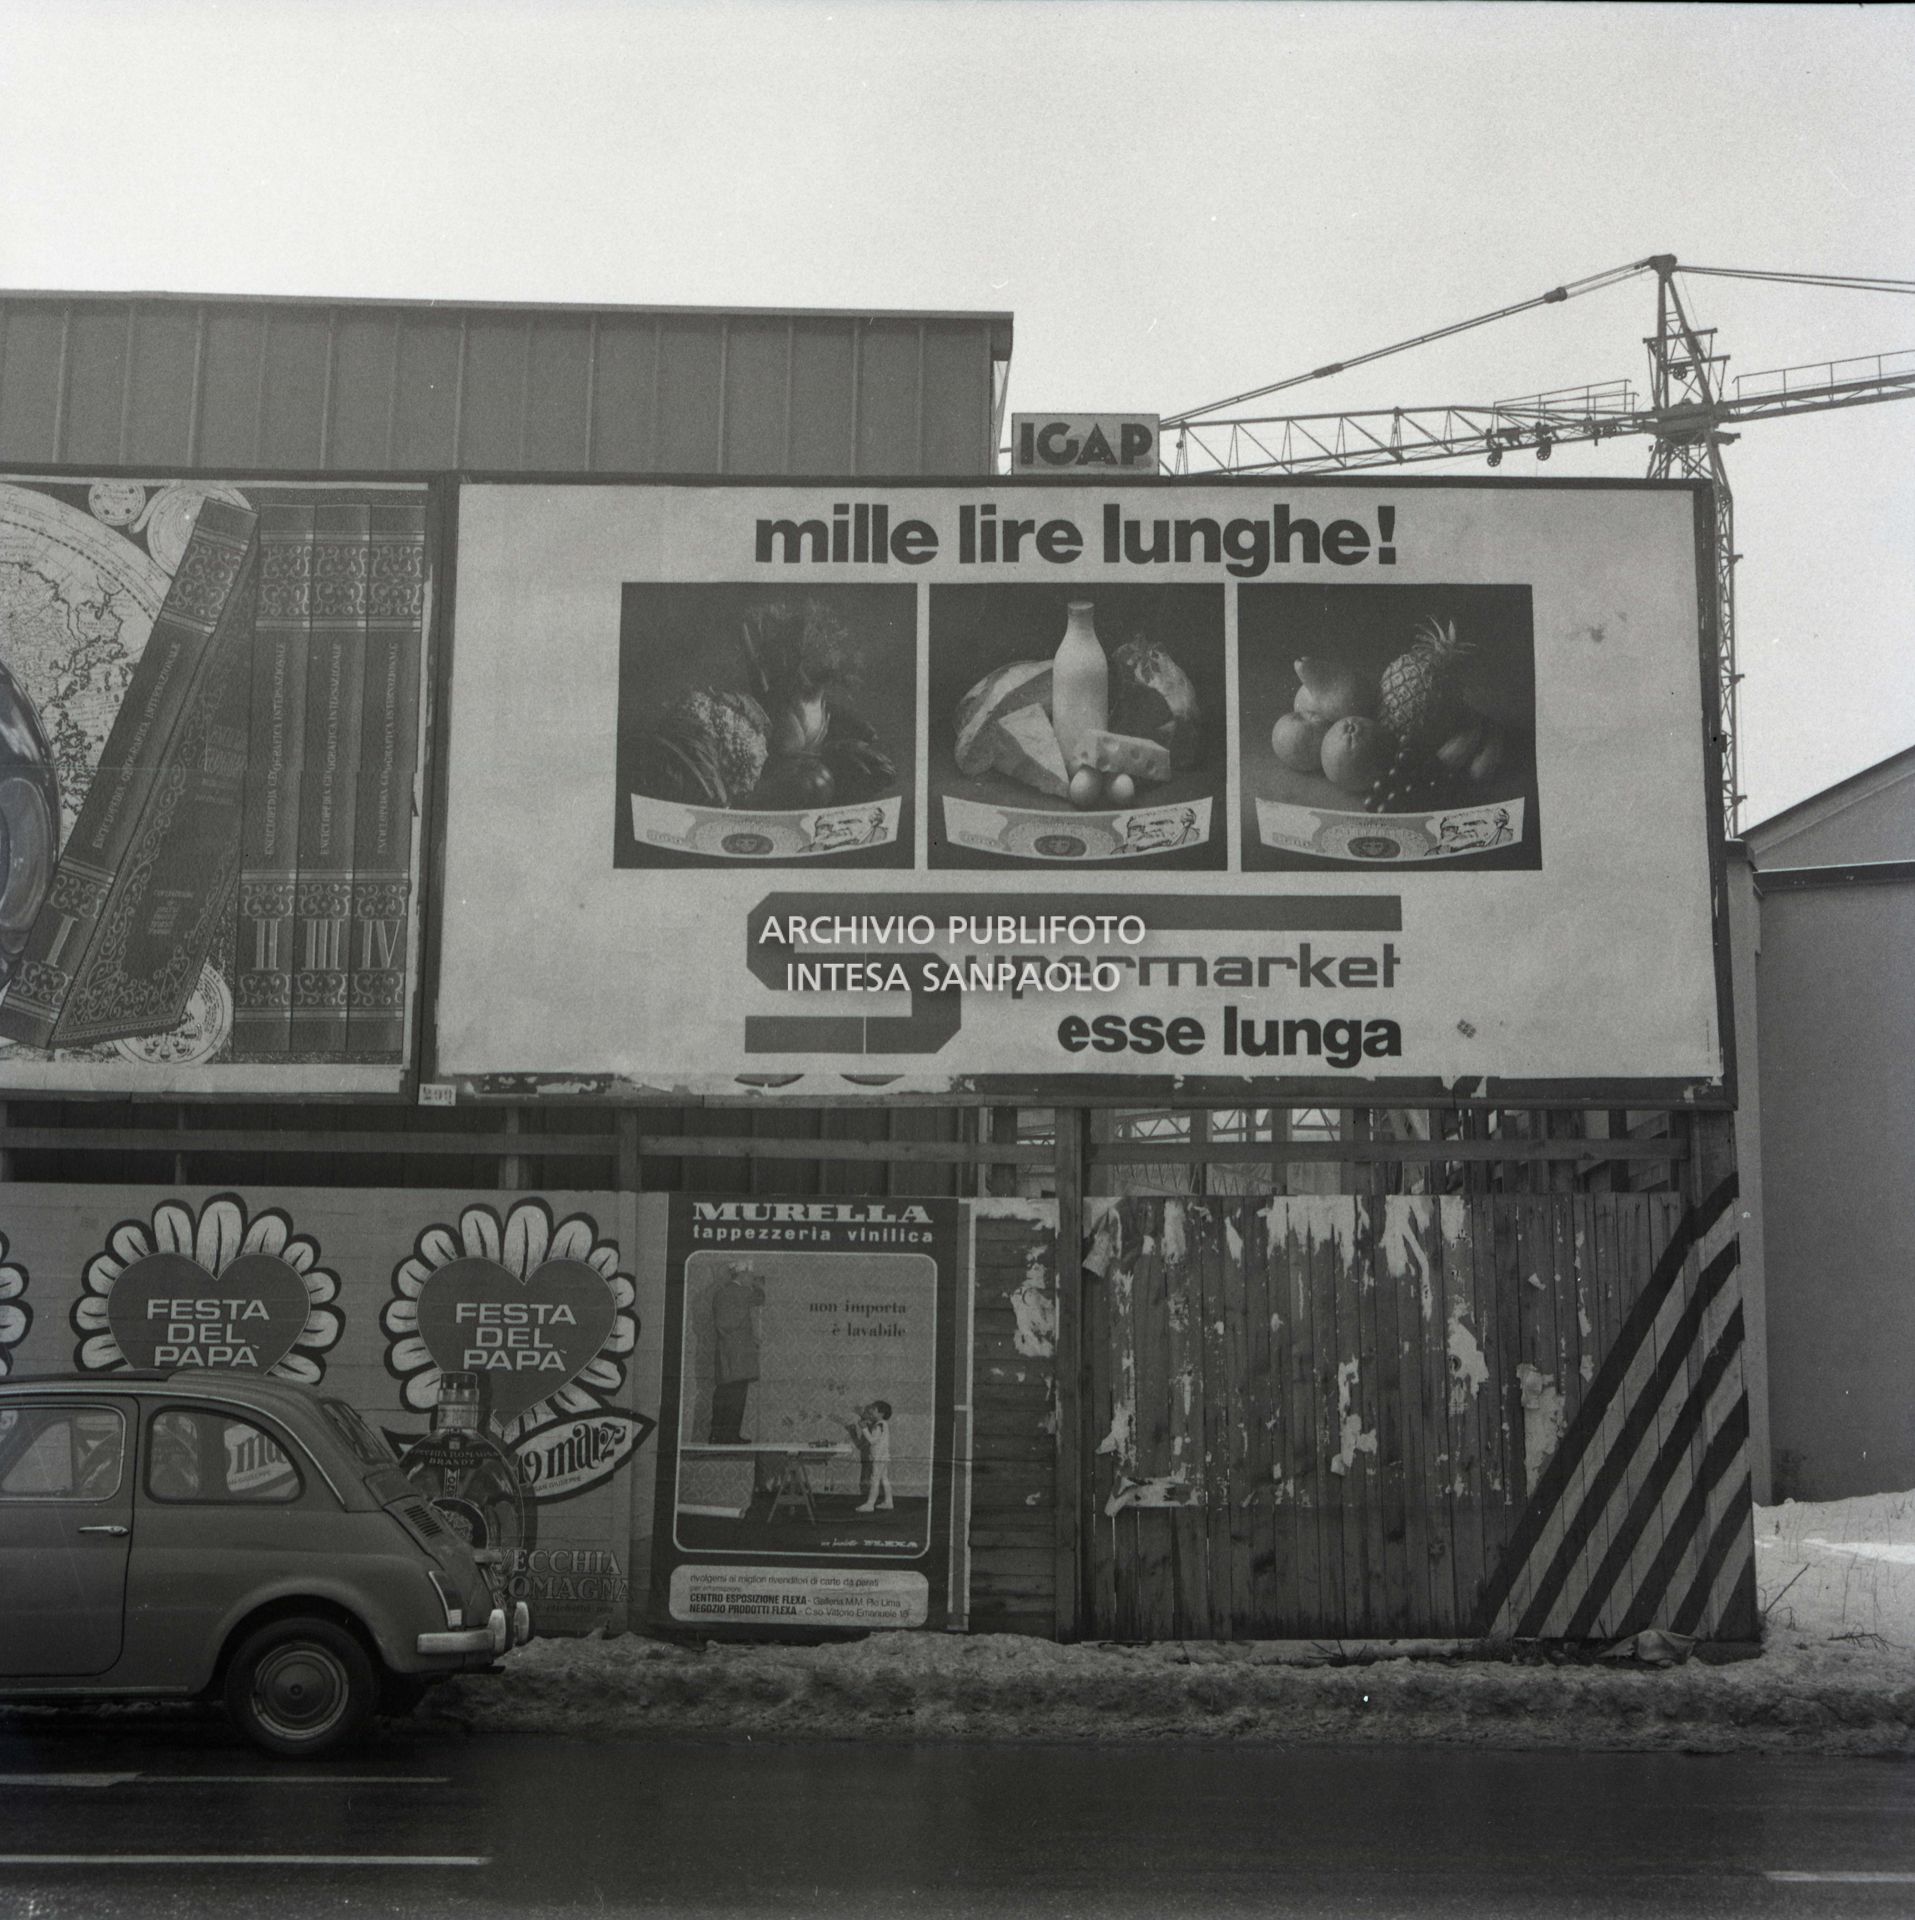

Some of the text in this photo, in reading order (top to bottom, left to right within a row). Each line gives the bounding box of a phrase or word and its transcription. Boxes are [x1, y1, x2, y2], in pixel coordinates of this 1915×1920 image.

[1020, 422, 1153, 466] IGAP
[755, 503, 1395, 576] mille lire lunghe!
[361, 917, 406, 970] IV
[1057, 1006, 1401, 1067] esse lunga
[693, 1202, 934, 1223] MURELLA
[693, 1225, 934, 1243] tappezzeria vinilica
[147, 1299, 270, 1320] FESTA
[455, 1303, 577, 1326] FESTA
[809, 1300, 907, 1318] non importa
[167, 1323, 246, 1343] DEL
[476, 1327, 553, 1348] DEL
[831, 1323, 906, 1337] è lavabile
[428, 1457, 475, 1466] BRANDY
[517, 1450, 543, 1486] 19
[508, 1576, 634, 1602] OMAGNA
[690, 1593, 724, 1603] CENTRO
[726, 1593, 780, 1605] ESPOSIZIONE
[782, 1595, 807, 1605] FLEXA
[690, 1604, 727, 1615] NEGOZIO
[728, 1605, 770, 1616] PRODOTTI
[772, 1606, 798, 1616] FLEXA
[826, 1607, 855, 1619] Vittorio
[855, 1608, 898, 1620] Emanuele
